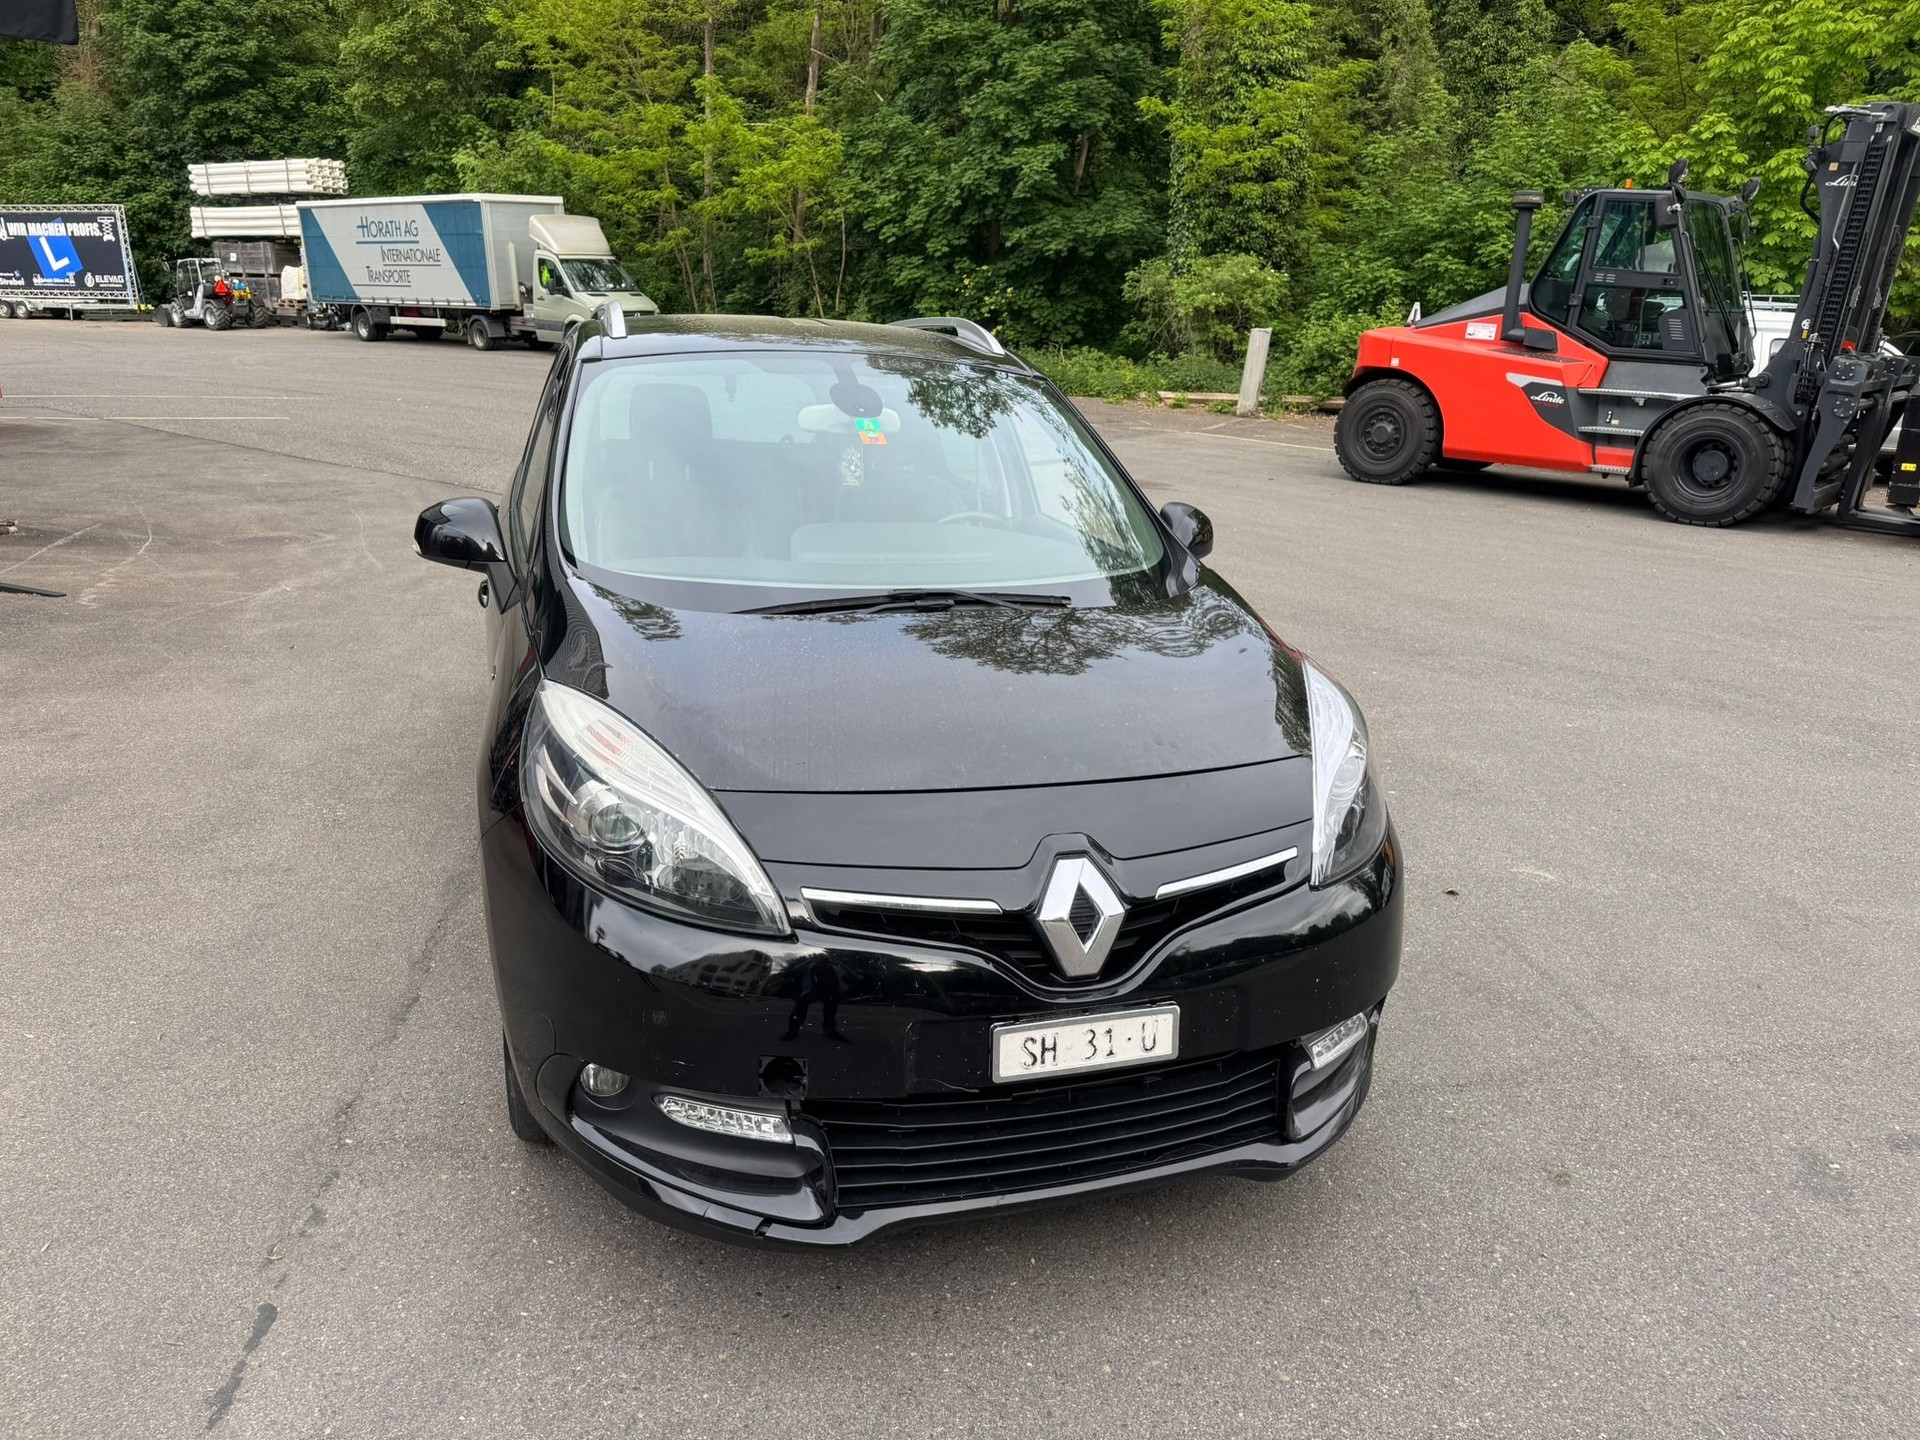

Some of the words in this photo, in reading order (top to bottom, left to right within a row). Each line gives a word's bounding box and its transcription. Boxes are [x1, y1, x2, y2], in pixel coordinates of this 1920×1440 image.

[6, 222, 28, 236] WIR
[27, 222, 67, 236] MACHEN
[66, 222, 103, 237] PROFIS.
[357, 216, 402, 238] HORATH
[404, 220, 419, 237] AG
[39, 236, 70, 271] L
[380, 245, 441, 262] INTERNATIONALE
[94, 275, 124, 283] ELEVAG
[365, 265, 411, 283] TRANSPORTE
[1530, 391, 1565, 404] Linde
[1023, 1032, 1058, 1070] SH
